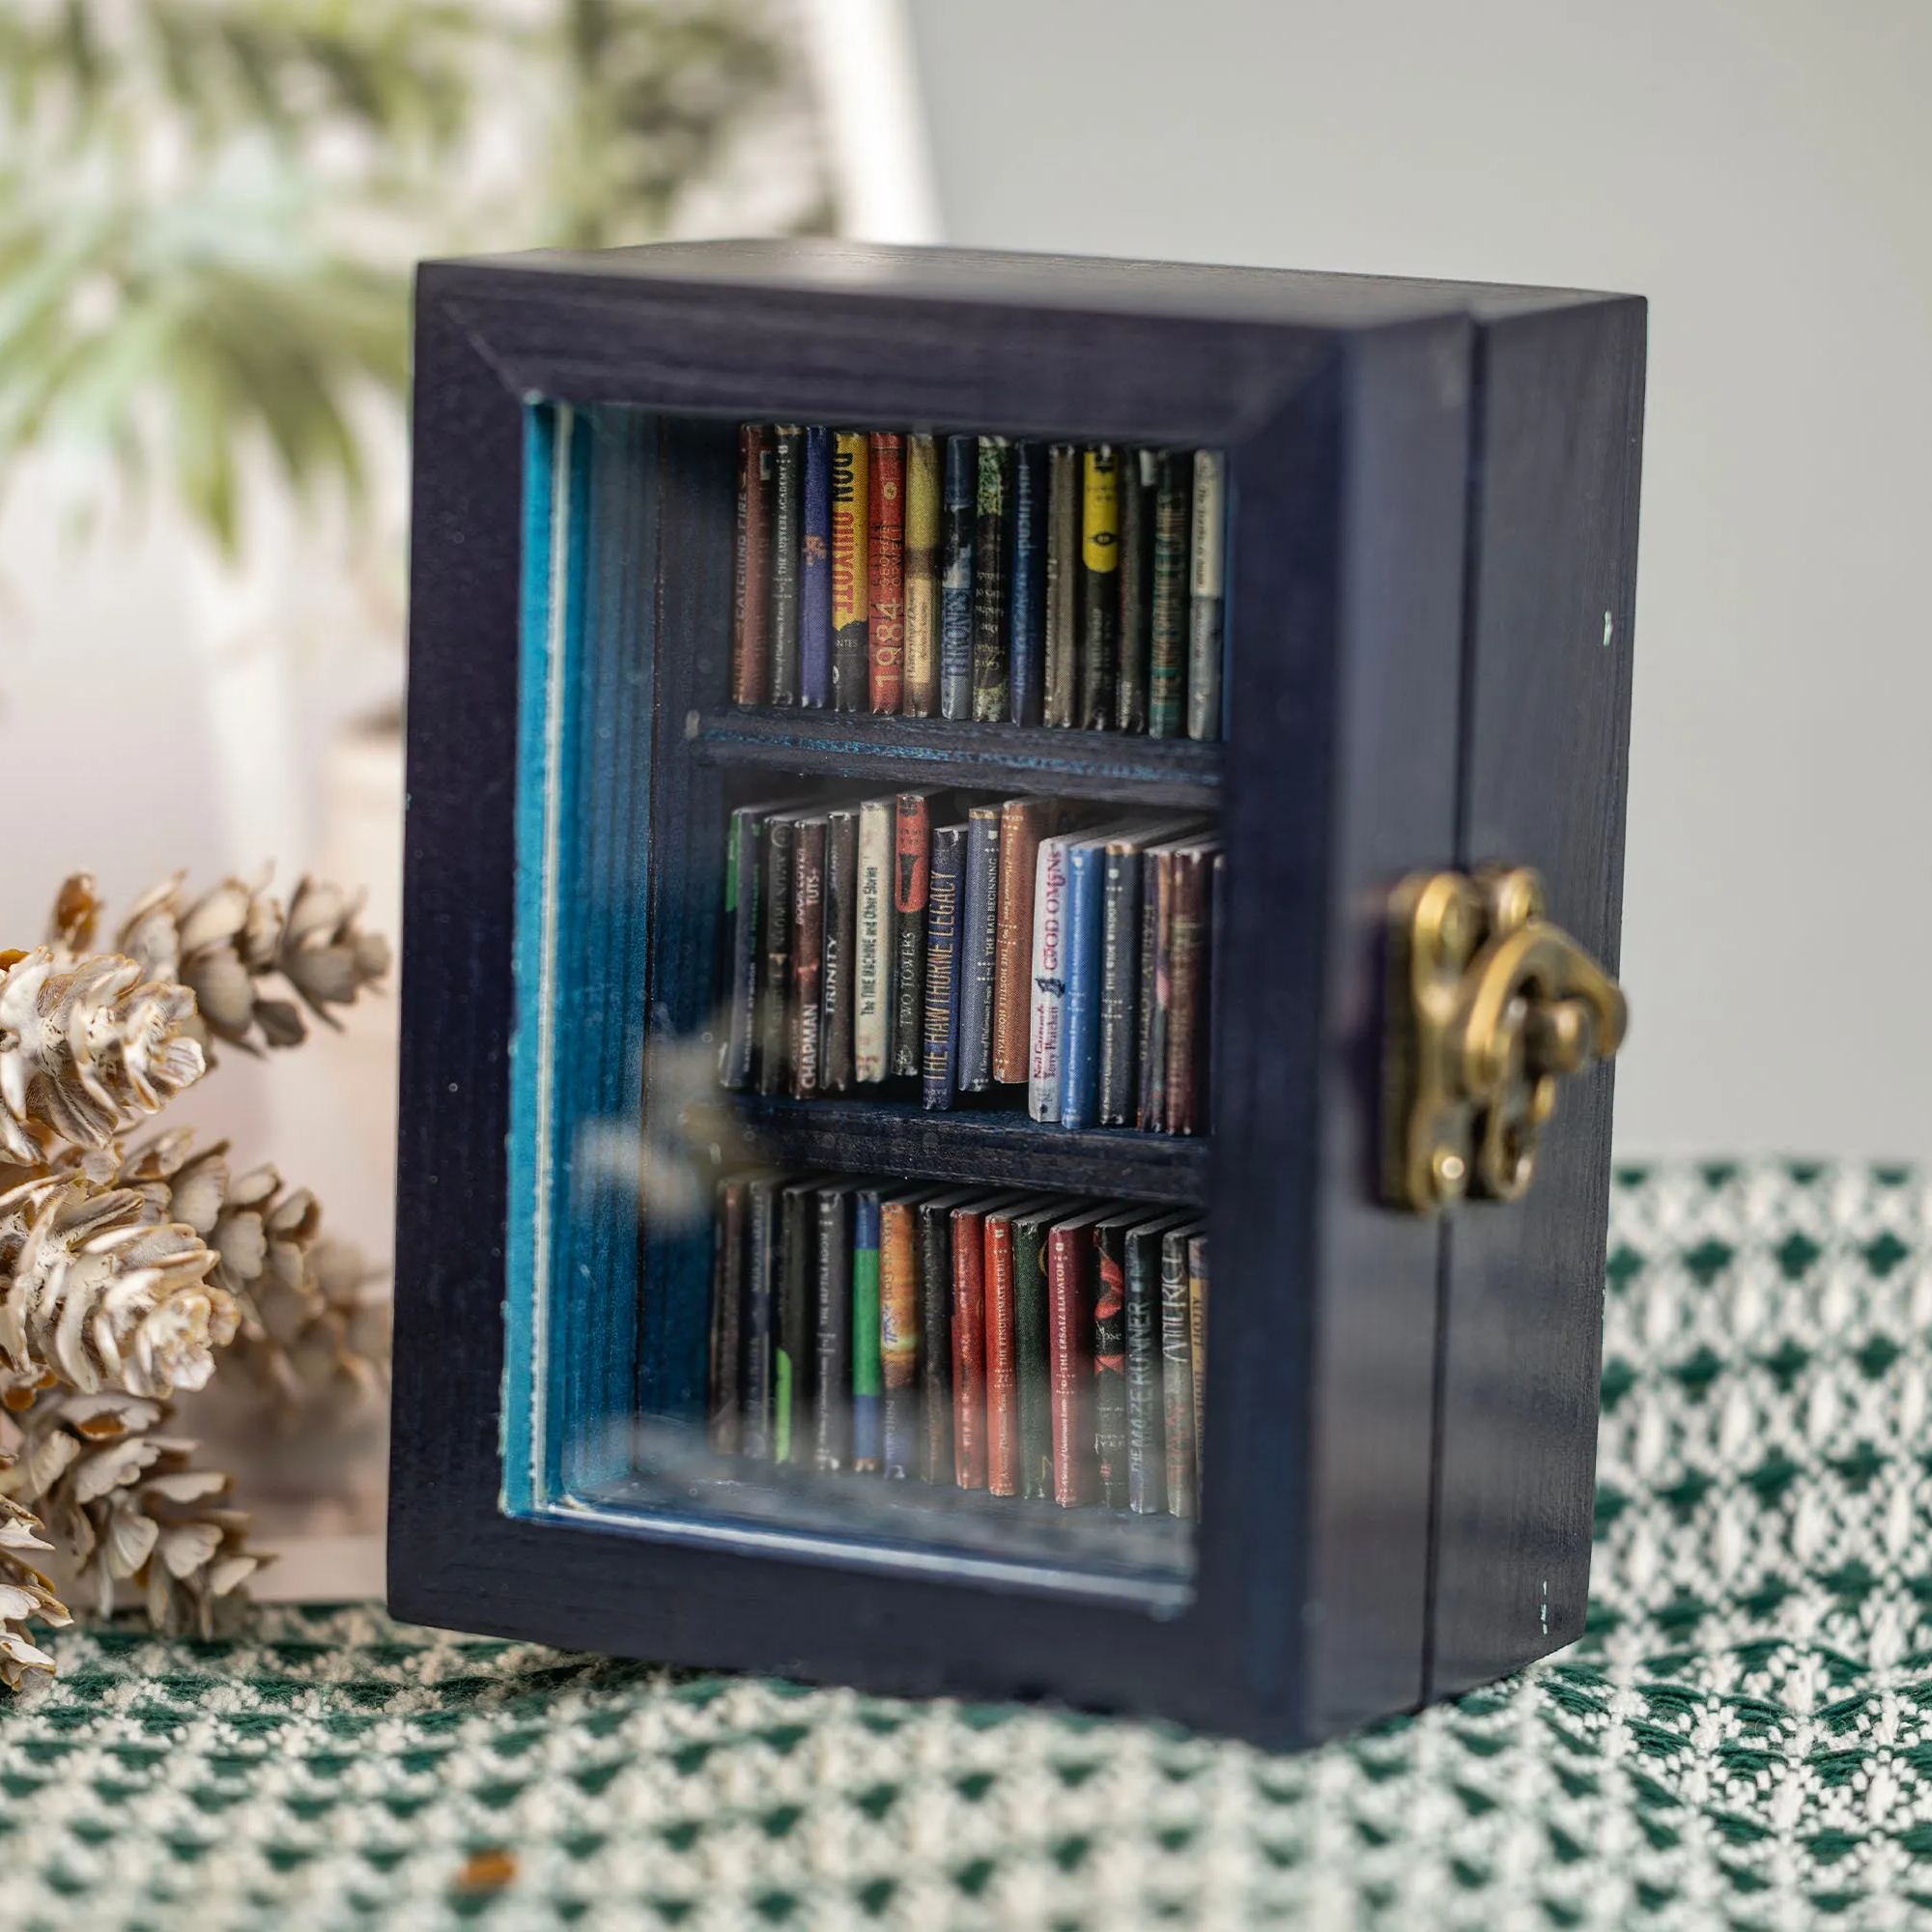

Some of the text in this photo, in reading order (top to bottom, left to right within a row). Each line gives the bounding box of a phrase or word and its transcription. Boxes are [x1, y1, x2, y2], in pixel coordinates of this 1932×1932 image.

[778, 467, 787, 512] ACADEMY
[832, 452, 854, 502] DON
[737, 493, 747, 529] FIRE
[778, 557, 787, 575] THE
[879, 525, 891, 588] GEORGE
[874, 597, 904, 688] 1984
[863, 867, 879, 895] Stories
[929, 870, 957, 937] LEGACY
[862, 897, 878, 919] Other
[863, 922, 877, 935] and
[984, 858, 997, 956] THE BAD BEGINNING
[1042, 920, 1059, 971] GOOD
[825, 935, 838, 1015] TRINITY
[899, 932, 916, 1027] TWO TOWERS
[923, 944, 953, 1043] HAWTHORNE
[860, 1001, 875, 1015] The
[997, 948, 1009, 1055] THE HOSTILE HOSPITAL
[801, 1003, 818, 1089] CHAPMAN
[923, 1051, 949, 1080] THE
[1033, 1057, 1042, 1078] Neil
[1042, 1054, 1058, 1081] Terry
[819, 1232, 830, 1264] ROOM
[996, 1258, 1006, 1281] PERIL
[1057, 1263, 1066, 1312] ELEVATOR
[1059, 1315, 1067, 1350] ERSATZ
[1127, 1301, 1151, 1385] RUNNER
[1130, 1449, 1143, 1472] THE
